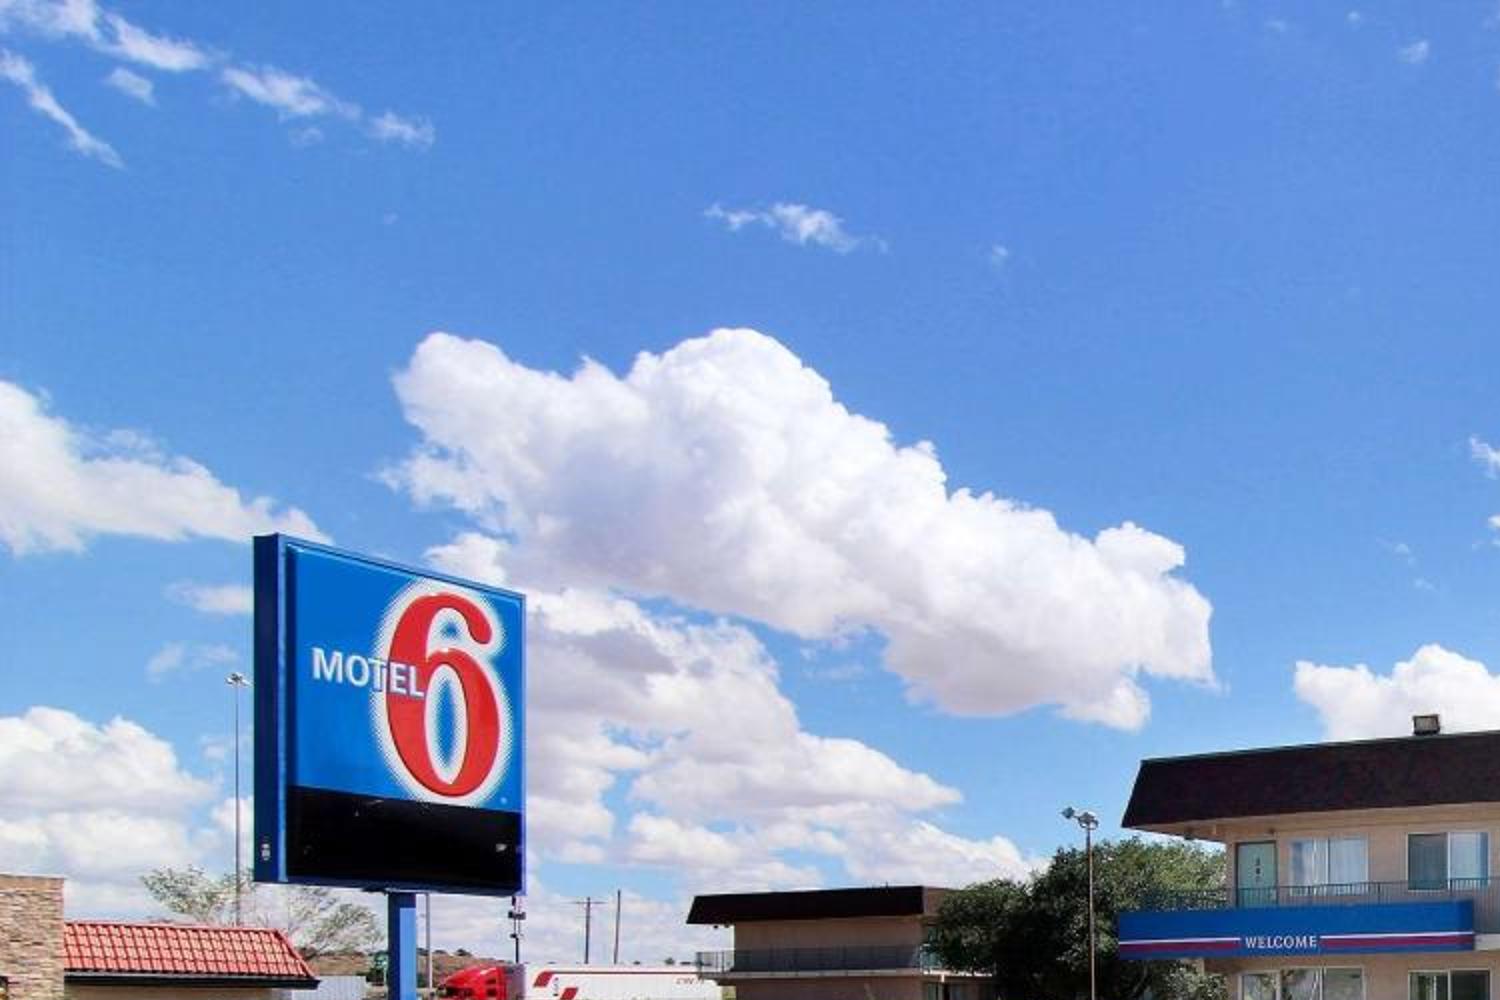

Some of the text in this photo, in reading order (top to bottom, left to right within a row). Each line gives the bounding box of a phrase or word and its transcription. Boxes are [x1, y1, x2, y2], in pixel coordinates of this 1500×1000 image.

[312, 591, 500, 798] MOTEL 6
[1245, 935, 1318, 949] WELCOME
